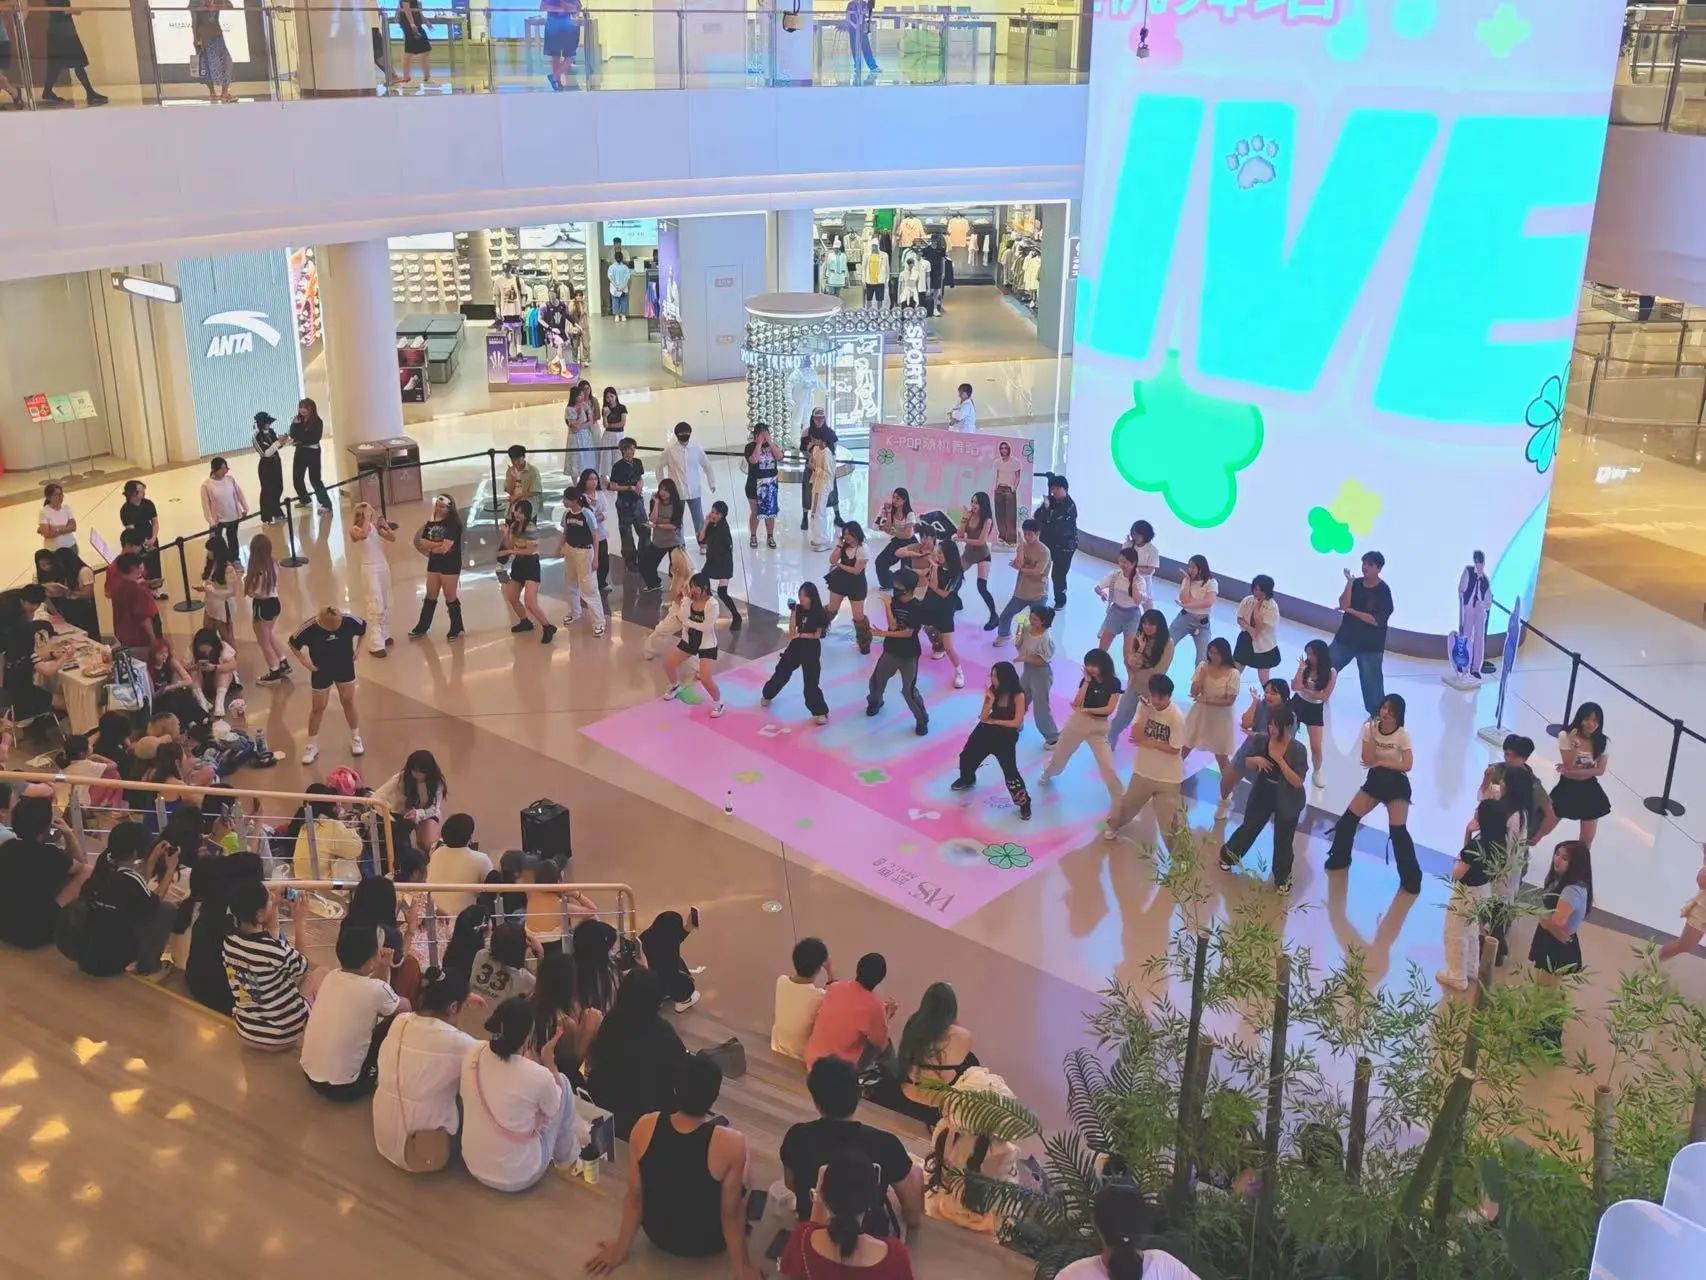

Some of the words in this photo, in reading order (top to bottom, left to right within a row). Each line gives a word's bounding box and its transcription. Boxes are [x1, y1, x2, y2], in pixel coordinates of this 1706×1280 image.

[1075, 95, 1606, 425] IVE
[206, 332, 254, 359] ANTA
[903, 324, 924, 388] SPORT
[476, 962, 511, 991] 33
